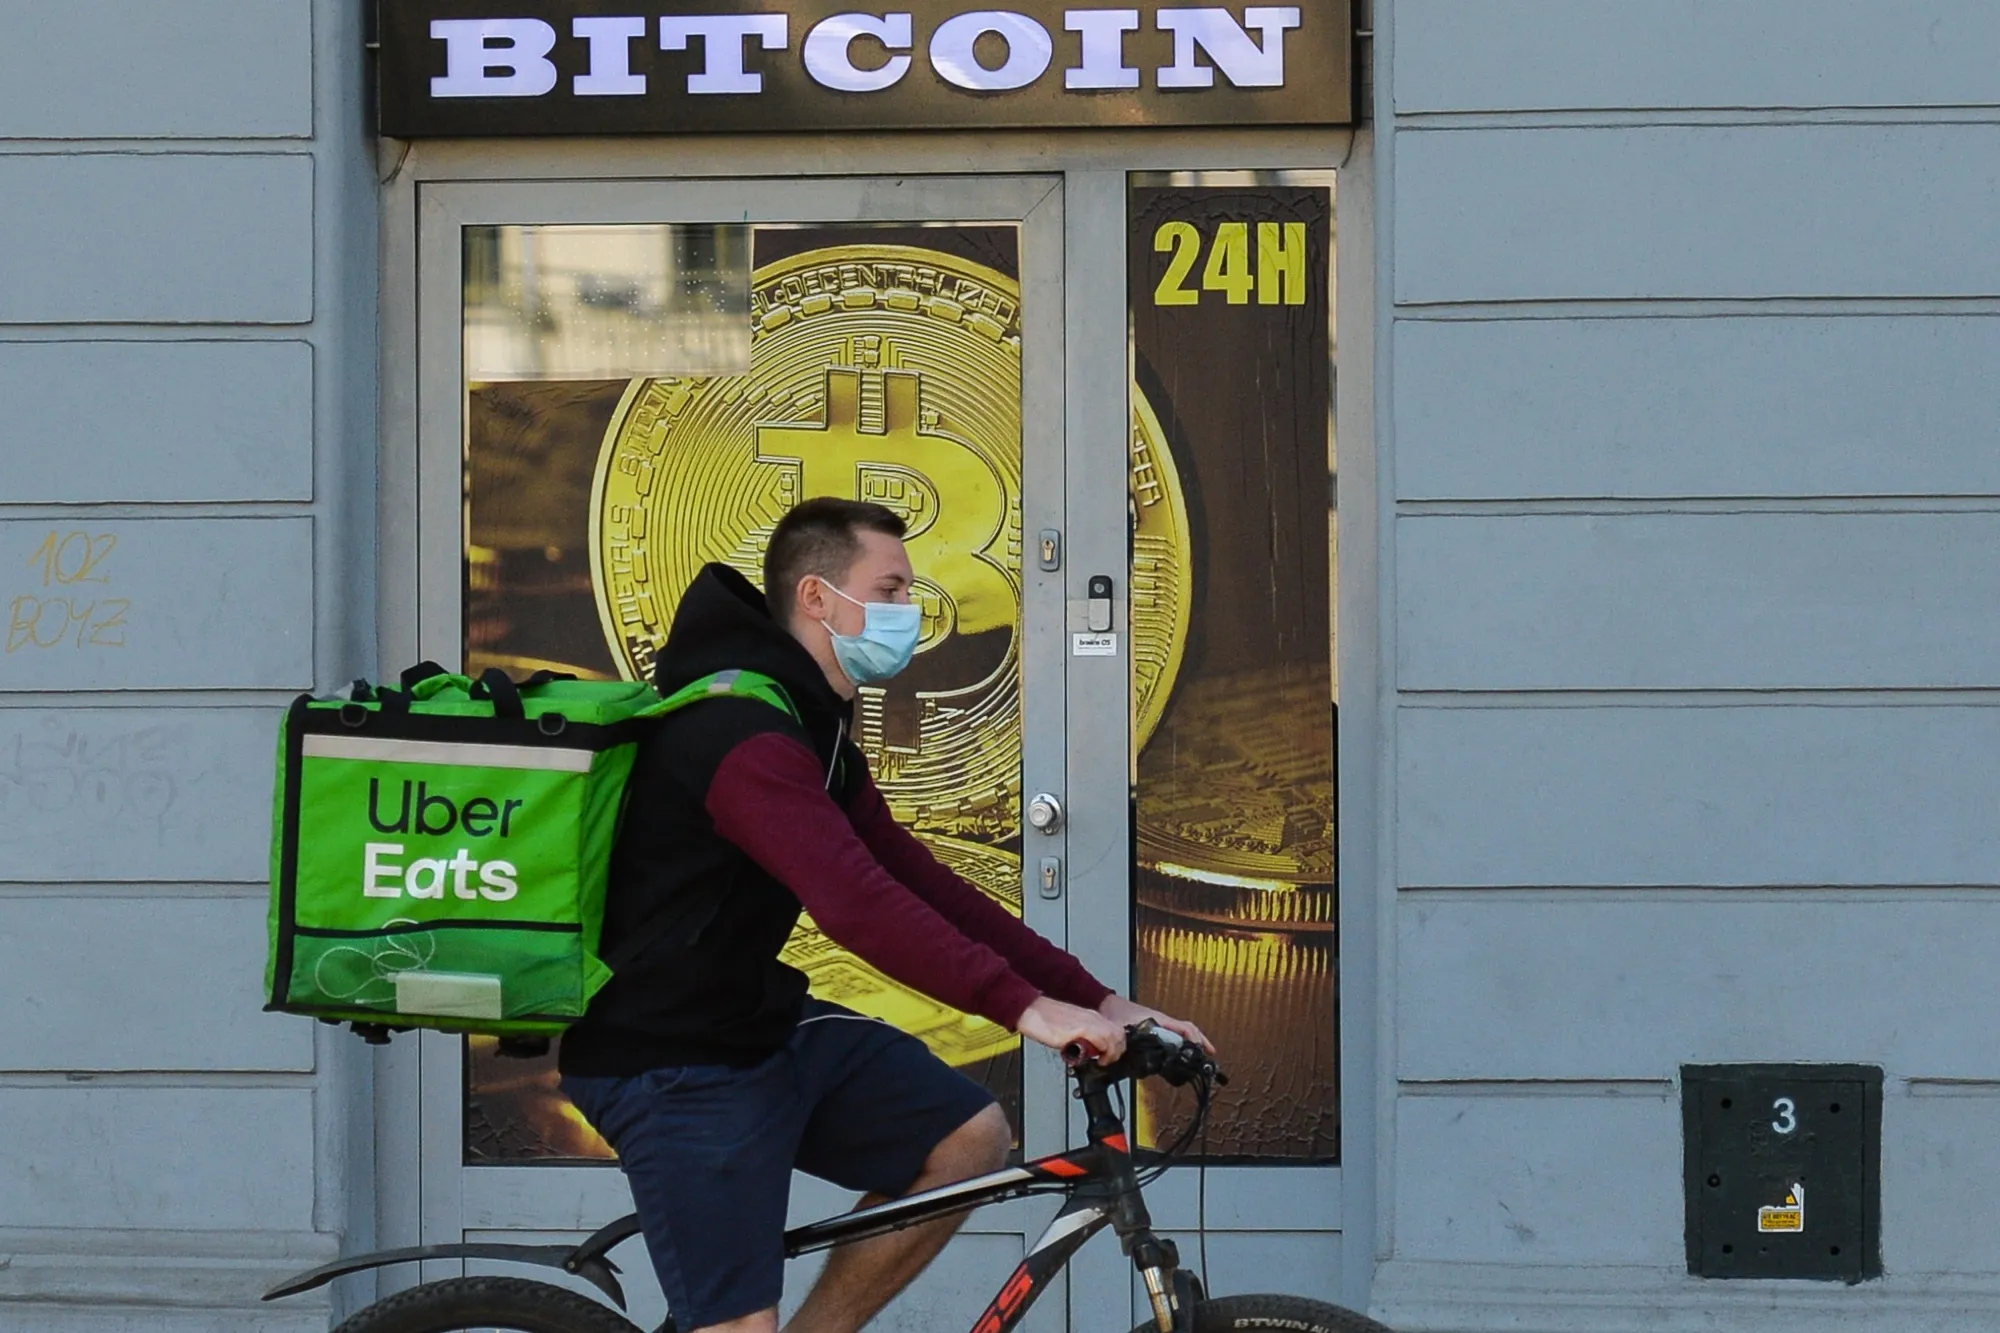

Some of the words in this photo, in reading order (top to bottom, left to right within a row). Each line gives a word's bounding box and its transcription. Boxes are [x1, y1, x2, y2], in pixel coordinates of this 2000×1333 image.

[430, 7, 1302, 98] BITCOIN
[1154, 221, 1306, 305] 24H
[28, 530, 117, 586] 102
[368, 777, 523, 838] Uber
[363, 842, 518, 902] Eats
[1772, 1097, 1796, 1134] 3
